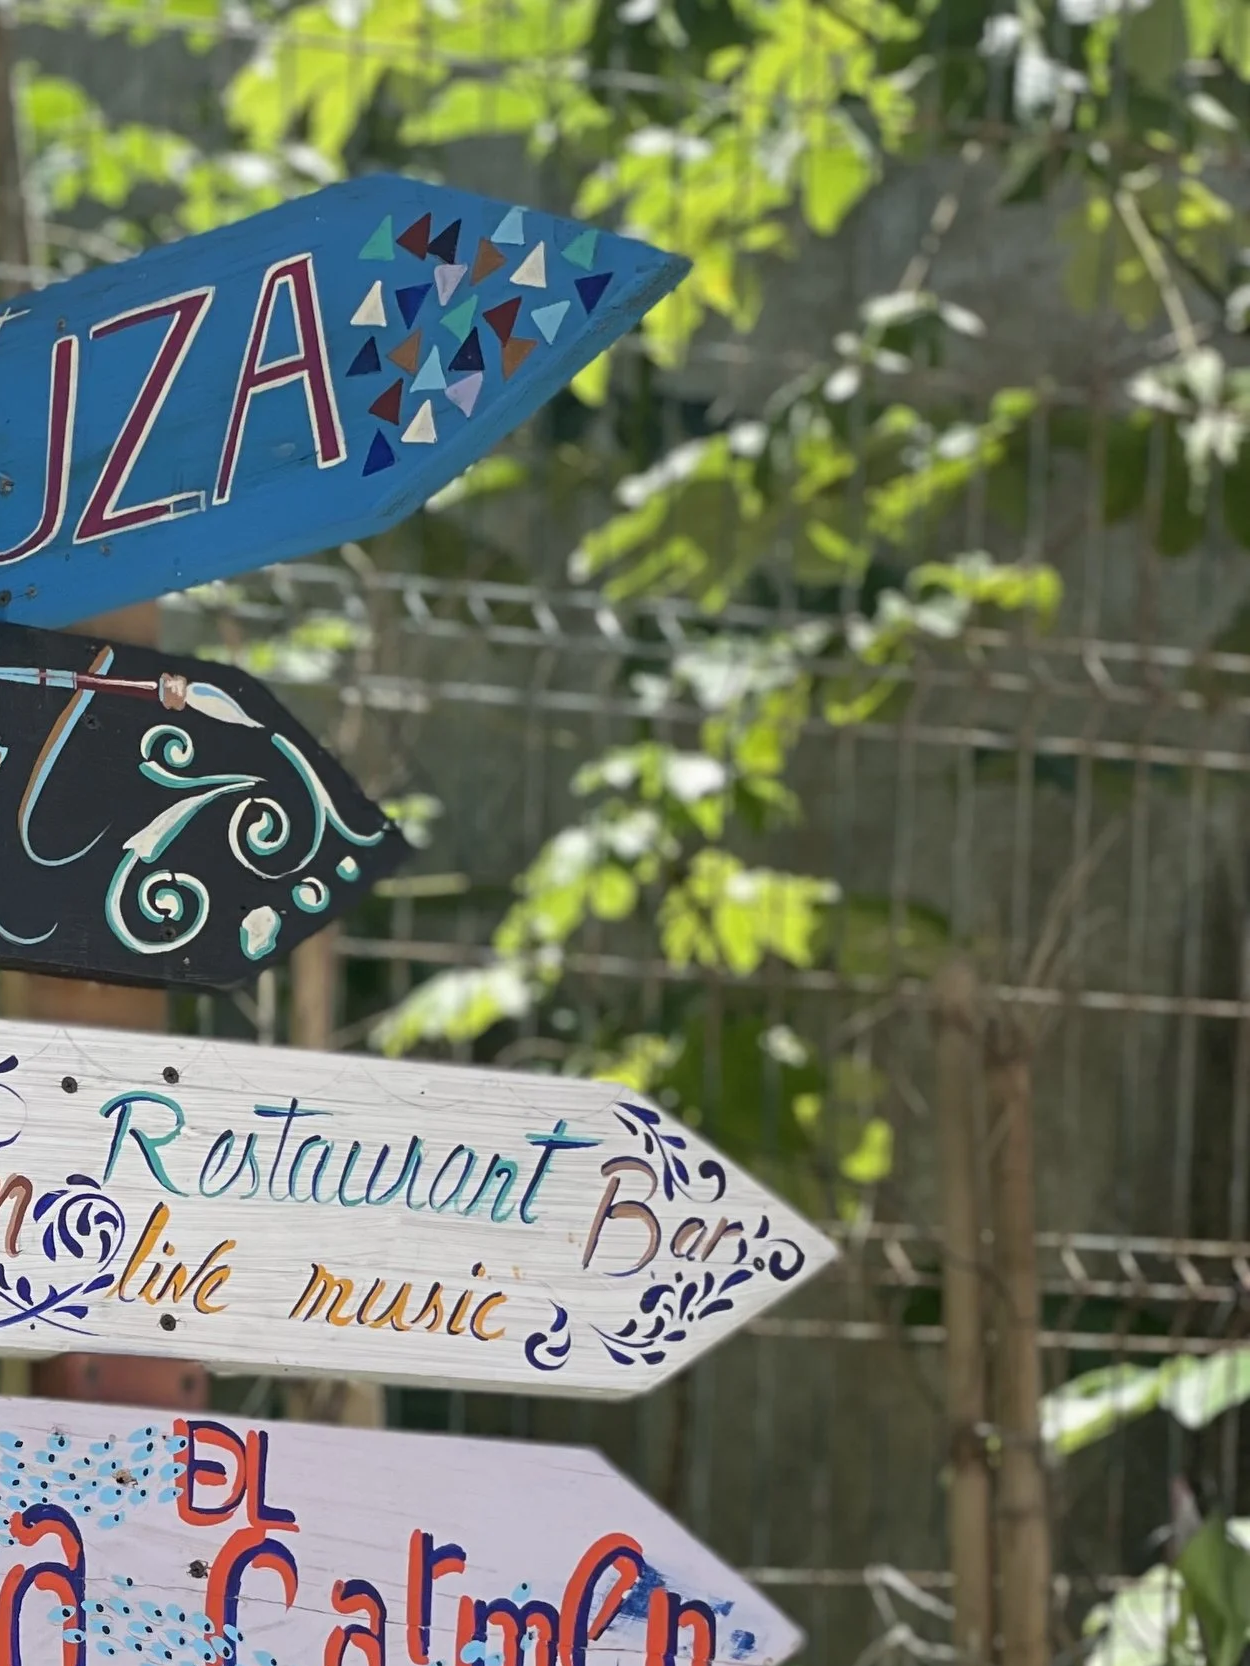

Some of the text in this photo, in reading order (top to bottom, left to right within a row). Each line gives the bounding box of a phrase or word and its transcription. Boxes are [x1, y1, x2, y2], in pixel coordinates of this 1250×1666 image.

[100, 1089, 745, 1278] Restaurant Bar
[105, 1201, 507, 1343] live music
